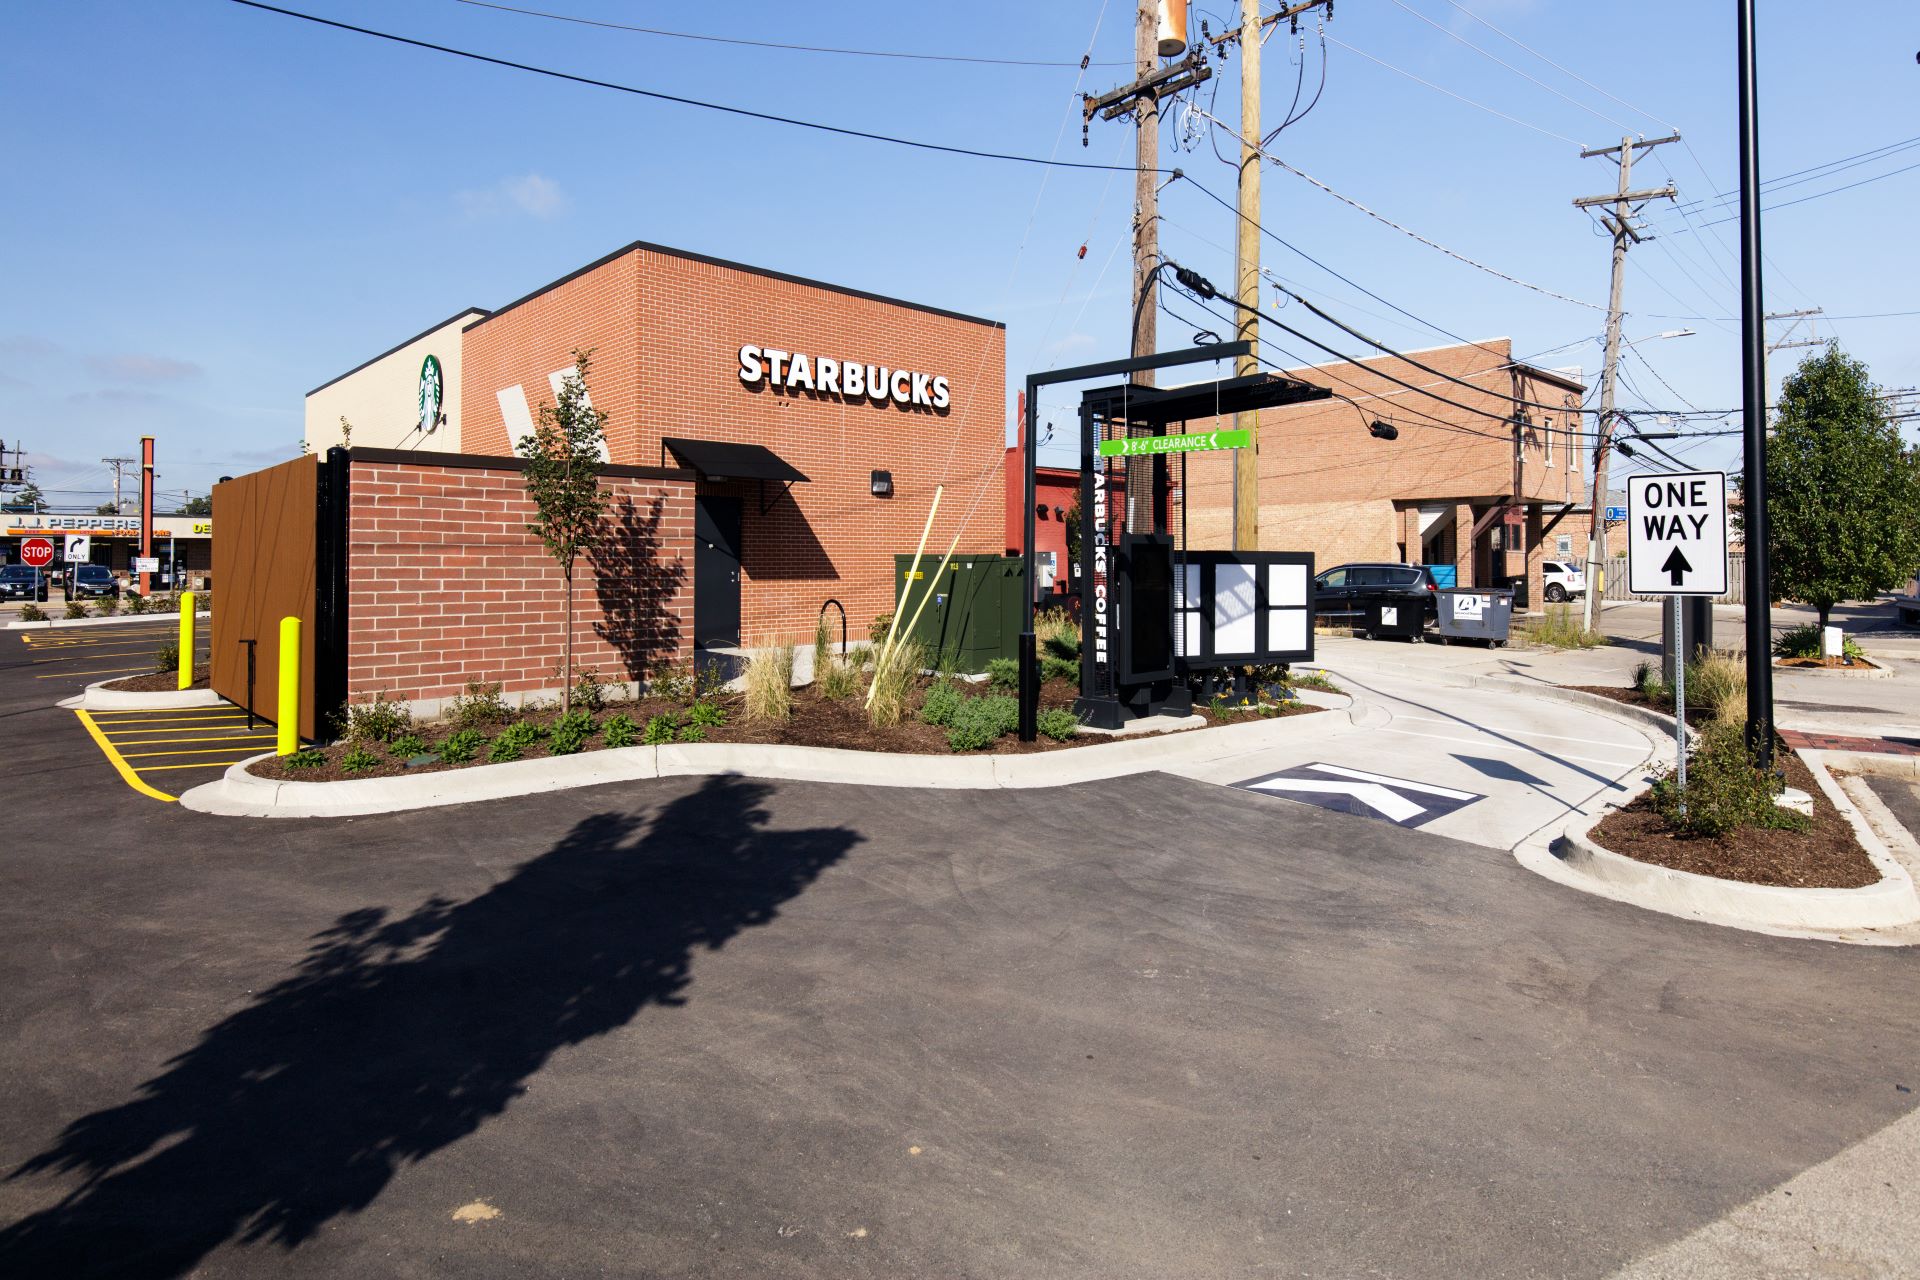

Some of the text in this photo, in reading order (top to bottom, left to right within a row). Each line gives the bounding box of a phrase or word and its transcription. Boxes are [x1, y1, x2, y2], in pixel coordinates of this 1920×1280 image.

[739, 344, 950, 408] STARBUCKS
[1153, 434, 1207, 450] CLEARANCE
[1644, 480, 1708, 509] ONE
[48, 518, 140, 529] PEPPERS
[1643, 513, 1709, 541] WAY
[23, 546, 51, 558] STOP
[1095, 585, 1107, 663] COFFEE
